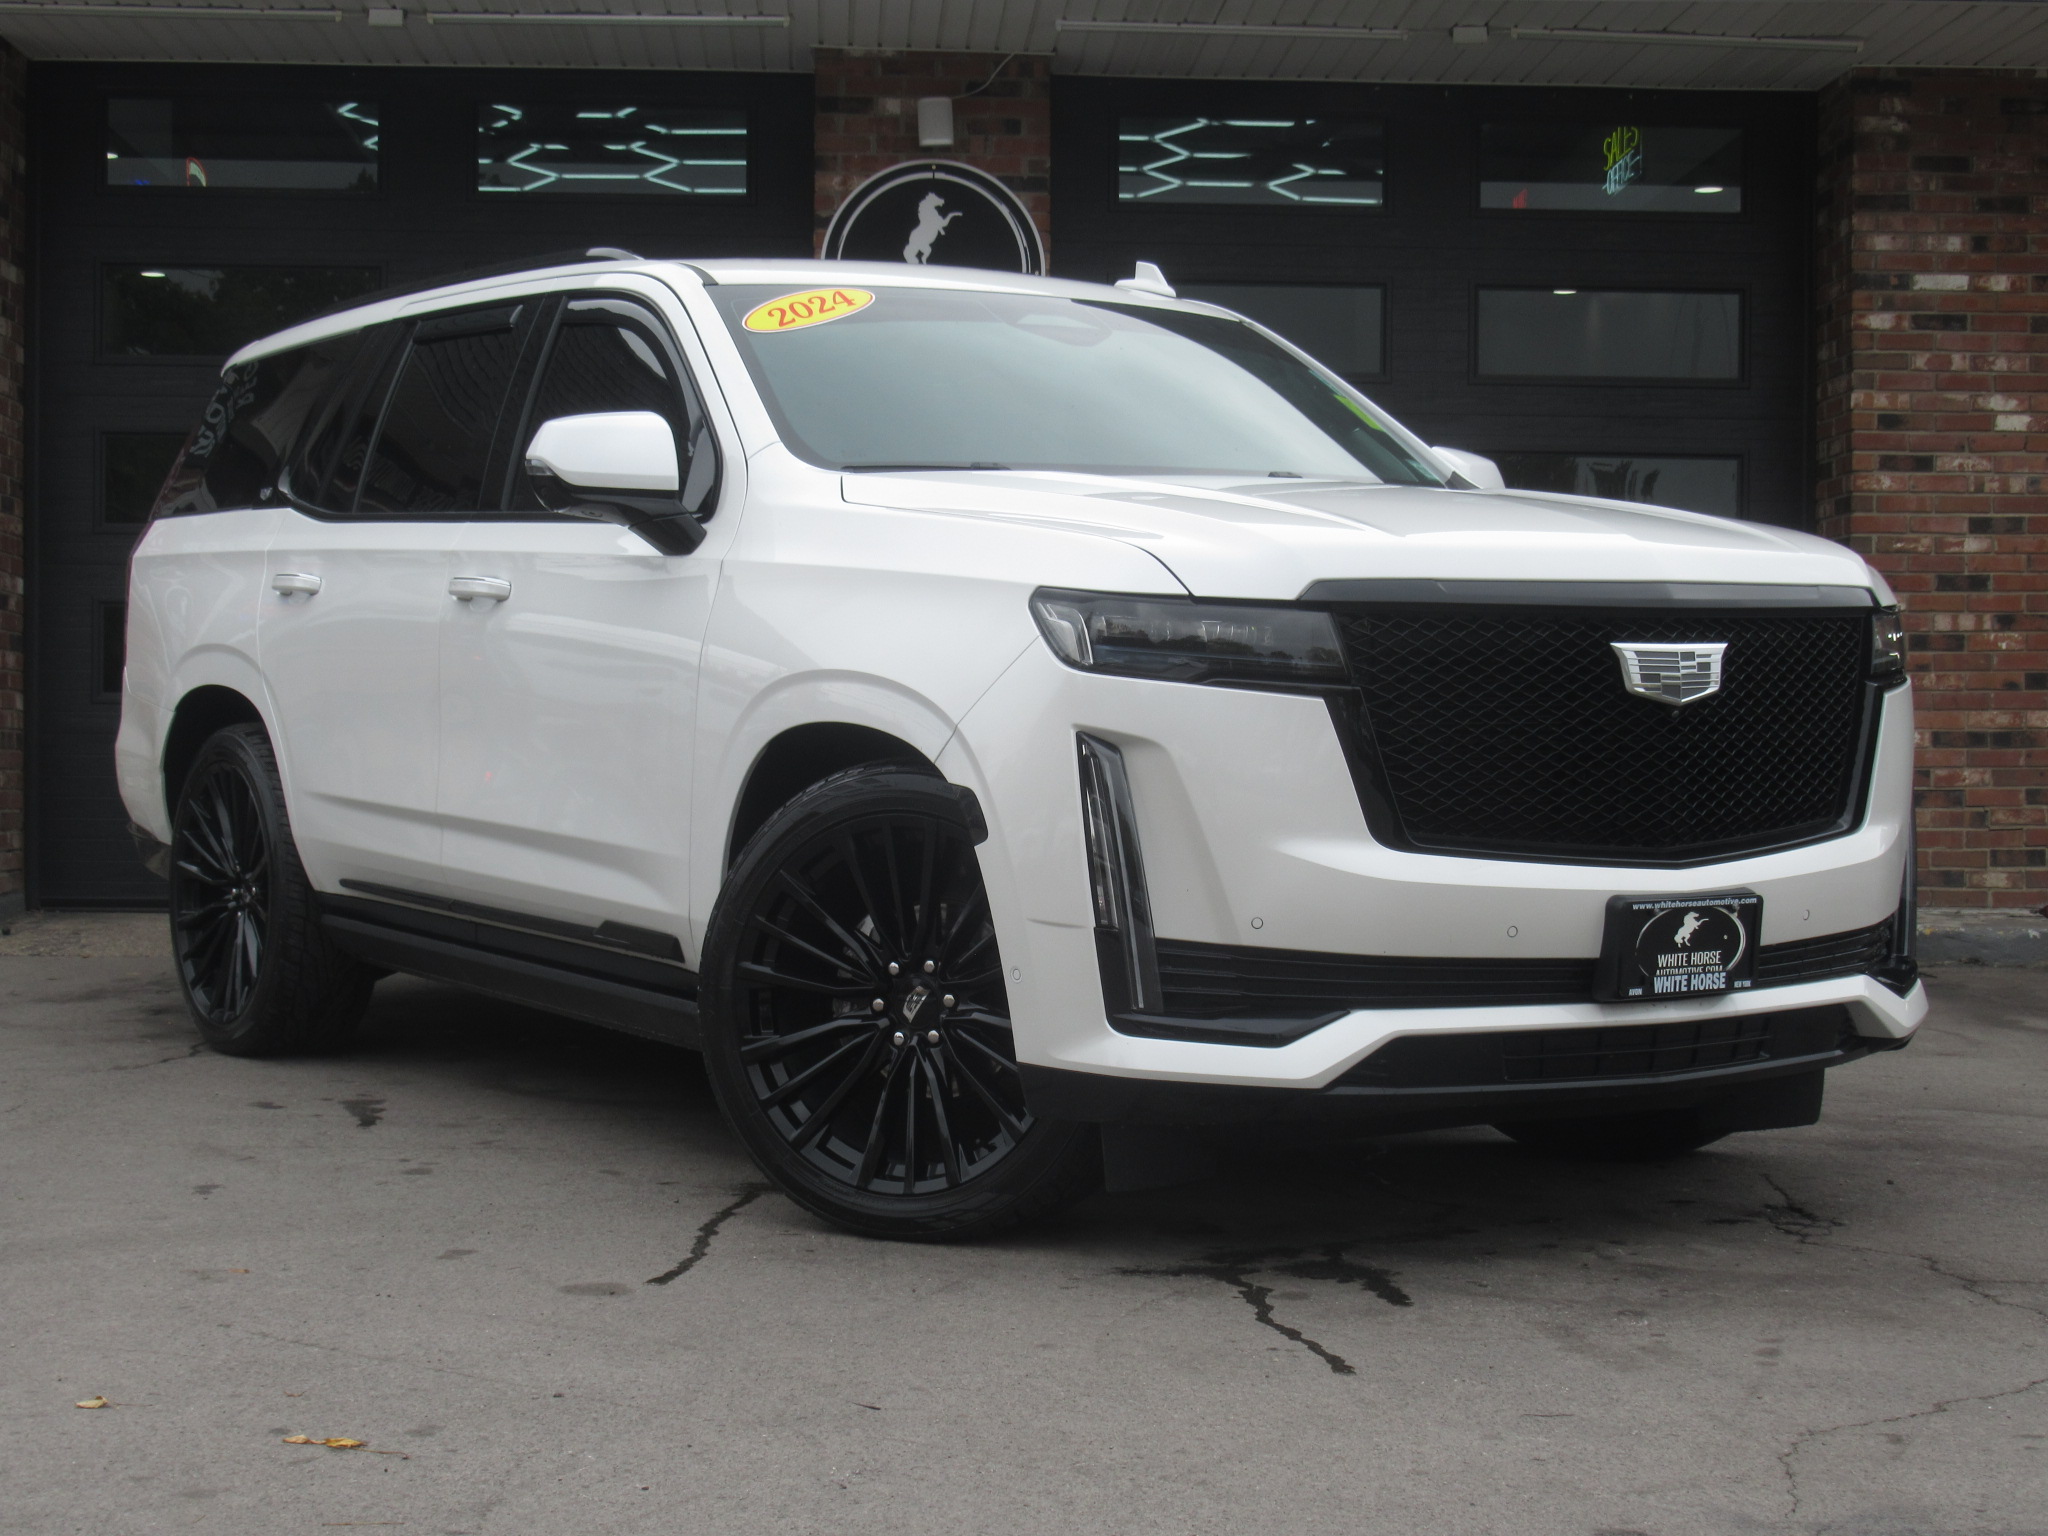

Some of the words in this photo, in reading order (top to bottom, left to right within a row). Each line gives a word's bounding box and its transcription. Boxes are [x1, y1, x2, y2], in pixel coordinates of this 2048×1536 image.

[1603, 126, 1639, 171] SALES
[767, 290, 856, 327] 2024
[1632, 897, 1757, 910] www.whitehorseautomotive.com
[1657, 952, 1688, 967] WHITE
[1690, 950, 1722, 965] HORSE
[1628, 988, 1643, 996] AVON
[1653, 975, 1688, 994] WHITE
[1690, 972, 1727, 990] HORSE
